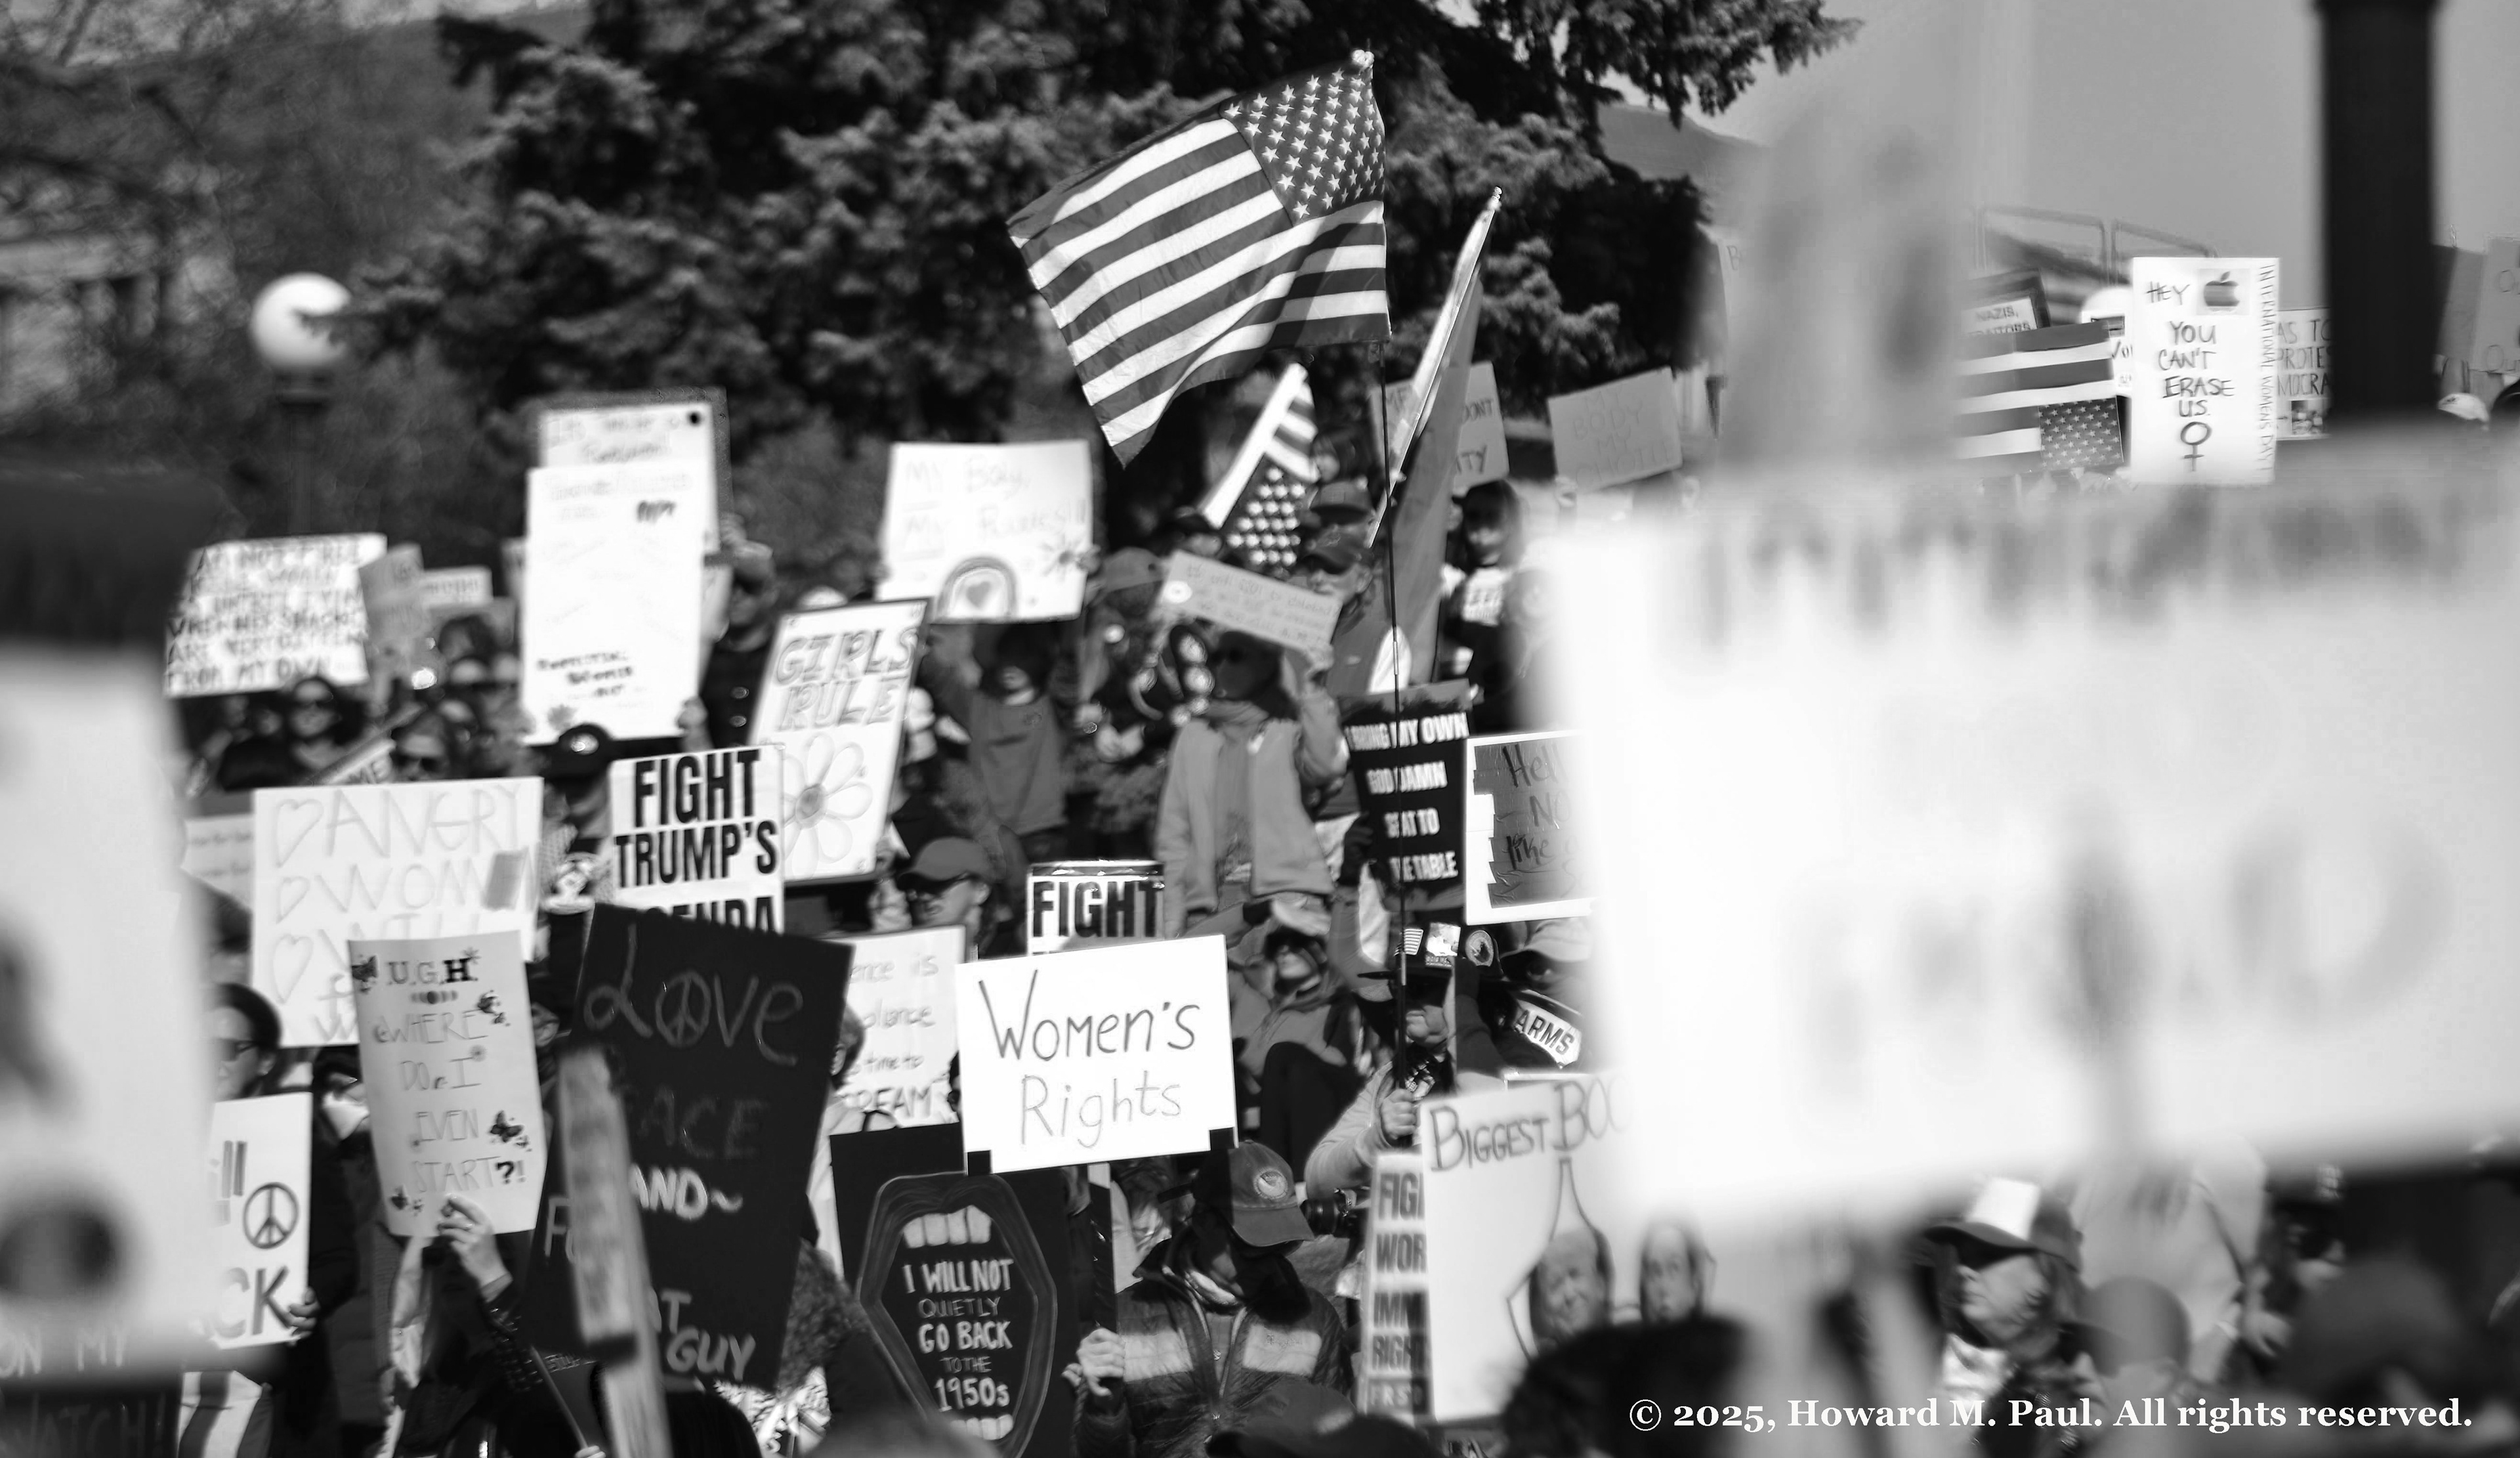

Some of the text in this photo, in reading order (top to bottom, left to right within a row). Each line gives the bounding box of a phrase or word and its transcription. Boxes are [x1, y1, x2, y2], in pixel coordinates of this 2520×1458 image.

[2147, 281, 2190, 305] HEY
[2170, 320, 2217, 345] YOU
[2158, 348, 2217, 371] CAN'T
[2162, 375, 2235, 399] ERASE
[1573, 399, 1644, 441] BODY
[777, 628, 919, 685] GIRLS
[778, 677, 908, 731] RULE
[1419, 712, 1470, 744] OWN
[635, 748, 761, 827] FIGHT
[326, 784, 525, 859] ANGRY
[1416, 807, 1440, 836] TO
[615, 820, 778, 888] TRUMP'S
[1032, 880, 1162, 938] FIGHT
[978, 968, 1200, 1061] Women's
[1514, 1009, 1575, 1057] ARMS
[413, 1108, 479, 1142] EVEN
[1021, 1070, 1182, 1148] Rights
[902, 1258, 1014, 1293] I WILL NOT
[917, 1297, 1001, 1318] QUIETLY
[665, 1326, 756, 1381] GUY
[919, 1319, 1013, 1354] GO BACK
[940, 1356, 992, 1373] TO THE
[934, 1377, 1010, 1412] 1950s
